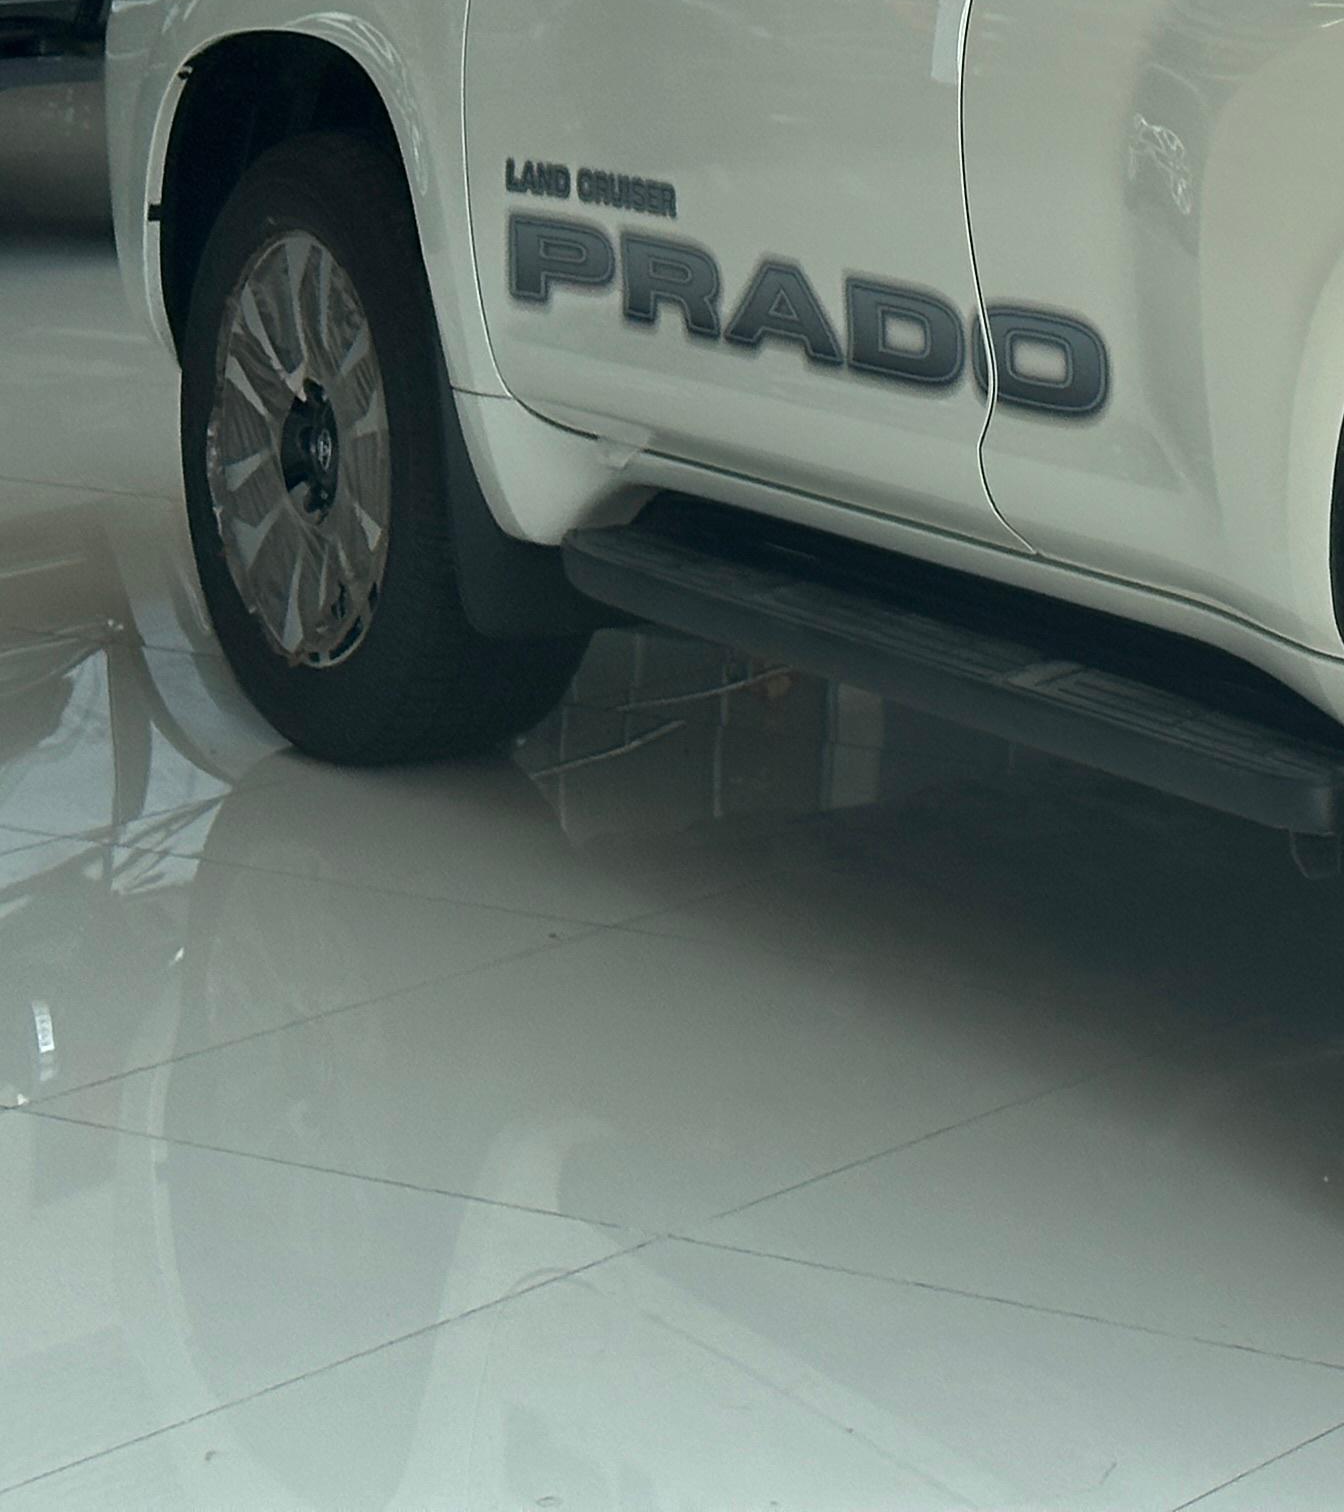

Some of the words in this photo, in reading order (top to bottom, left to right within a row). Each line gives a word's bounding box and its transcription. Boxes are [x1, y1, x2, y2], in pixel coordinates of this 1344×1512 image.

[505, 156, 571, 200] LAND
[576, 167, 678, 219] CRUISER
[506, 212, 1112, 416] PRADO
